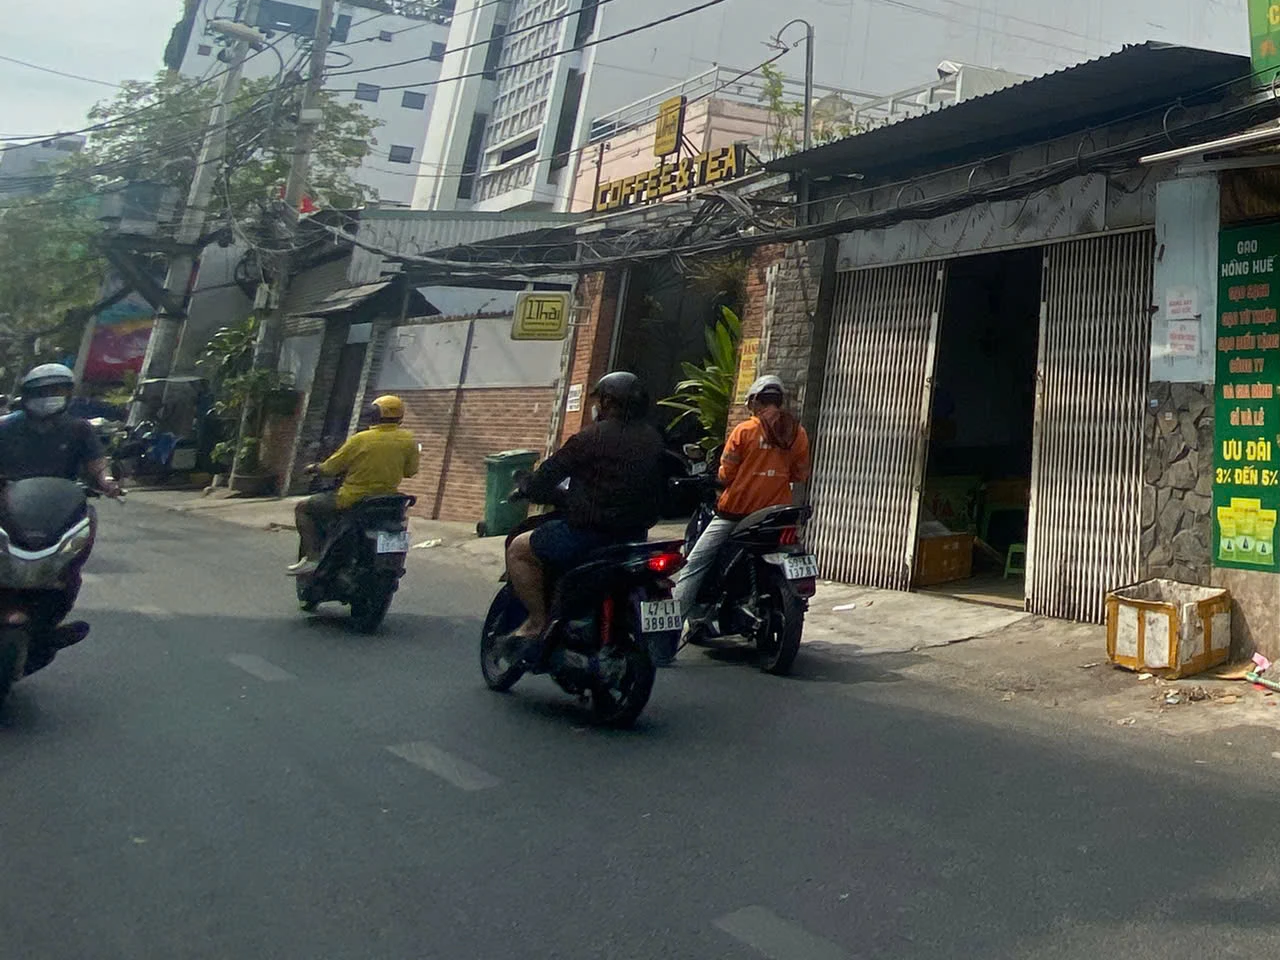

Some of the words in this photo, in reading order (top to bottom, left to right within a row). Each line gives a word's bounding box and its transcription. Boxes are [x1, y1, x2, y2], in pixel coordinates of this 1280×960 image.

[1237, 240, 1258, 256] GẠO
[1221, 259, 1249, 277] HỒNG
[1252, 254, 1278, 274] HUẾ
[1222, 438, 1242, 461] ƯU
[1245, 437, 1272, 462] ĐÃI
[1216, 468, 1231, 484] 3%
[1233, 464, 1258, 486] ĐẾN
[1261, 469, 1279, 486] 5%
